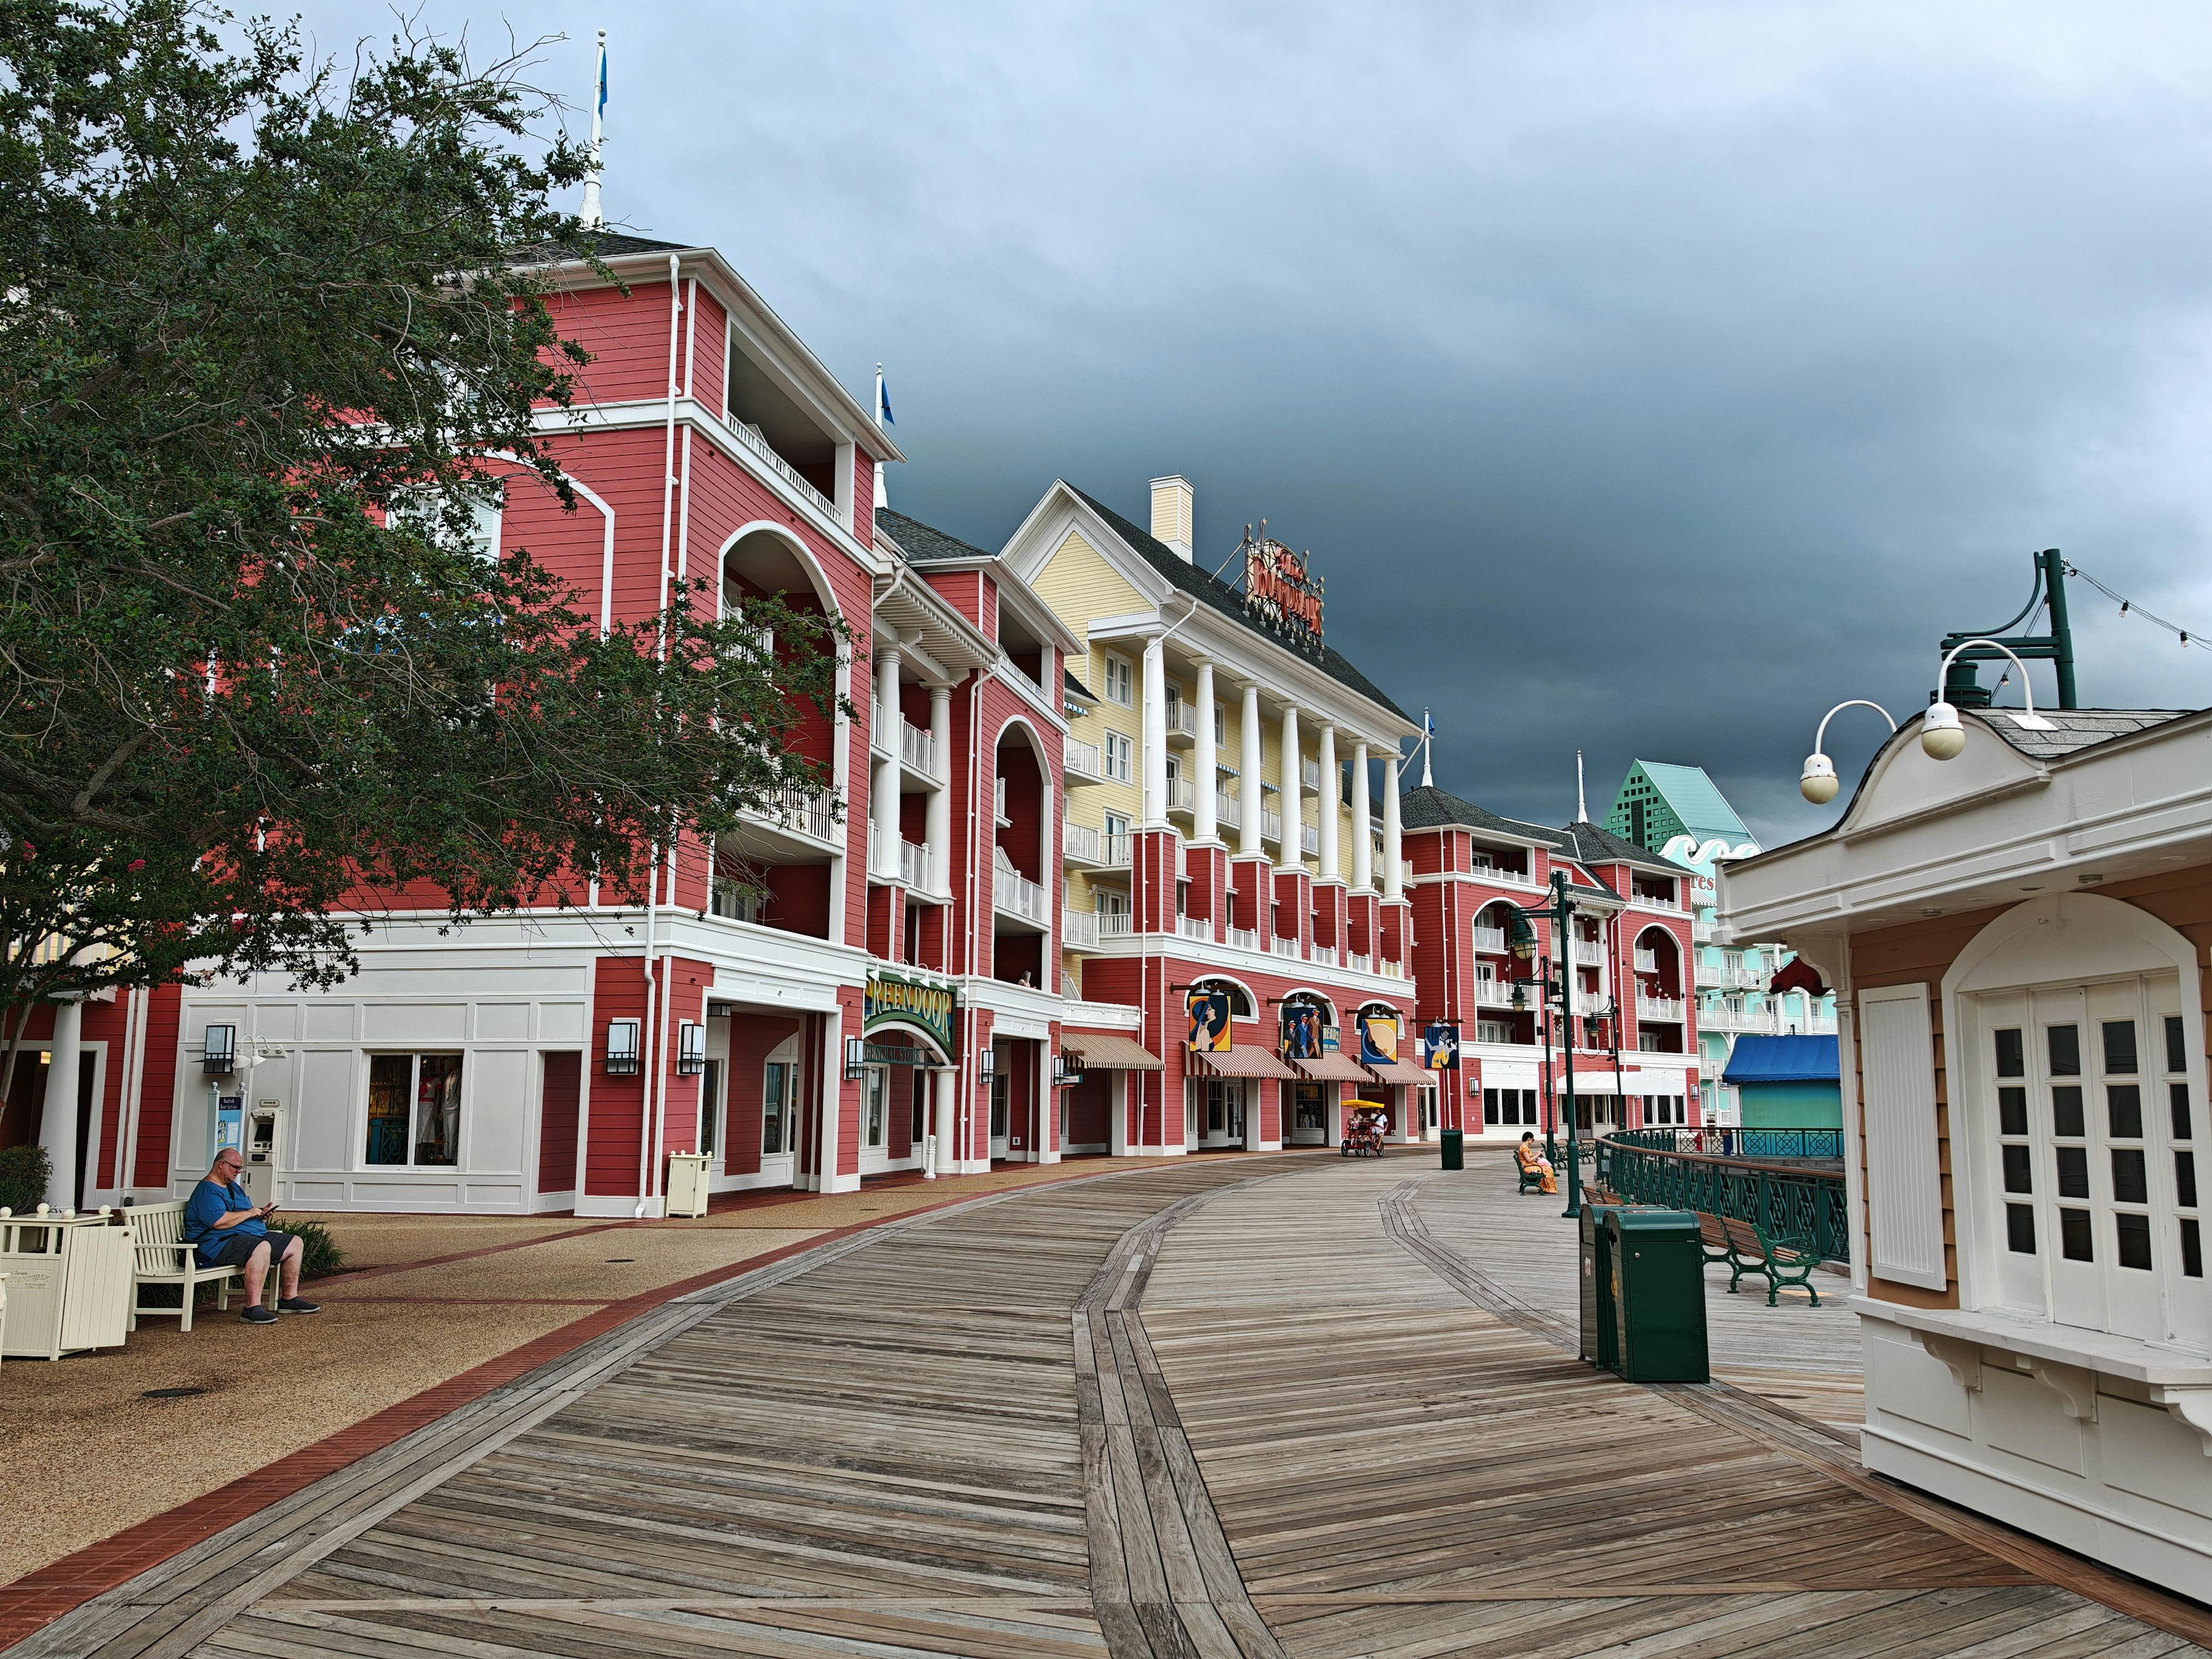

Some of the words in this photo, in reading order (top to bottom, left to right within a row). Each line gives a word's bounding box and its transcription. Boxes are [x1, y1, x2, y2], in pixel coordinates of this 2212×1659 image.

[1275, 547, 1304, 582] The
[865, 1045, 897, 1061] GENERAL
[899, 1048, 920, 1063] STORE
